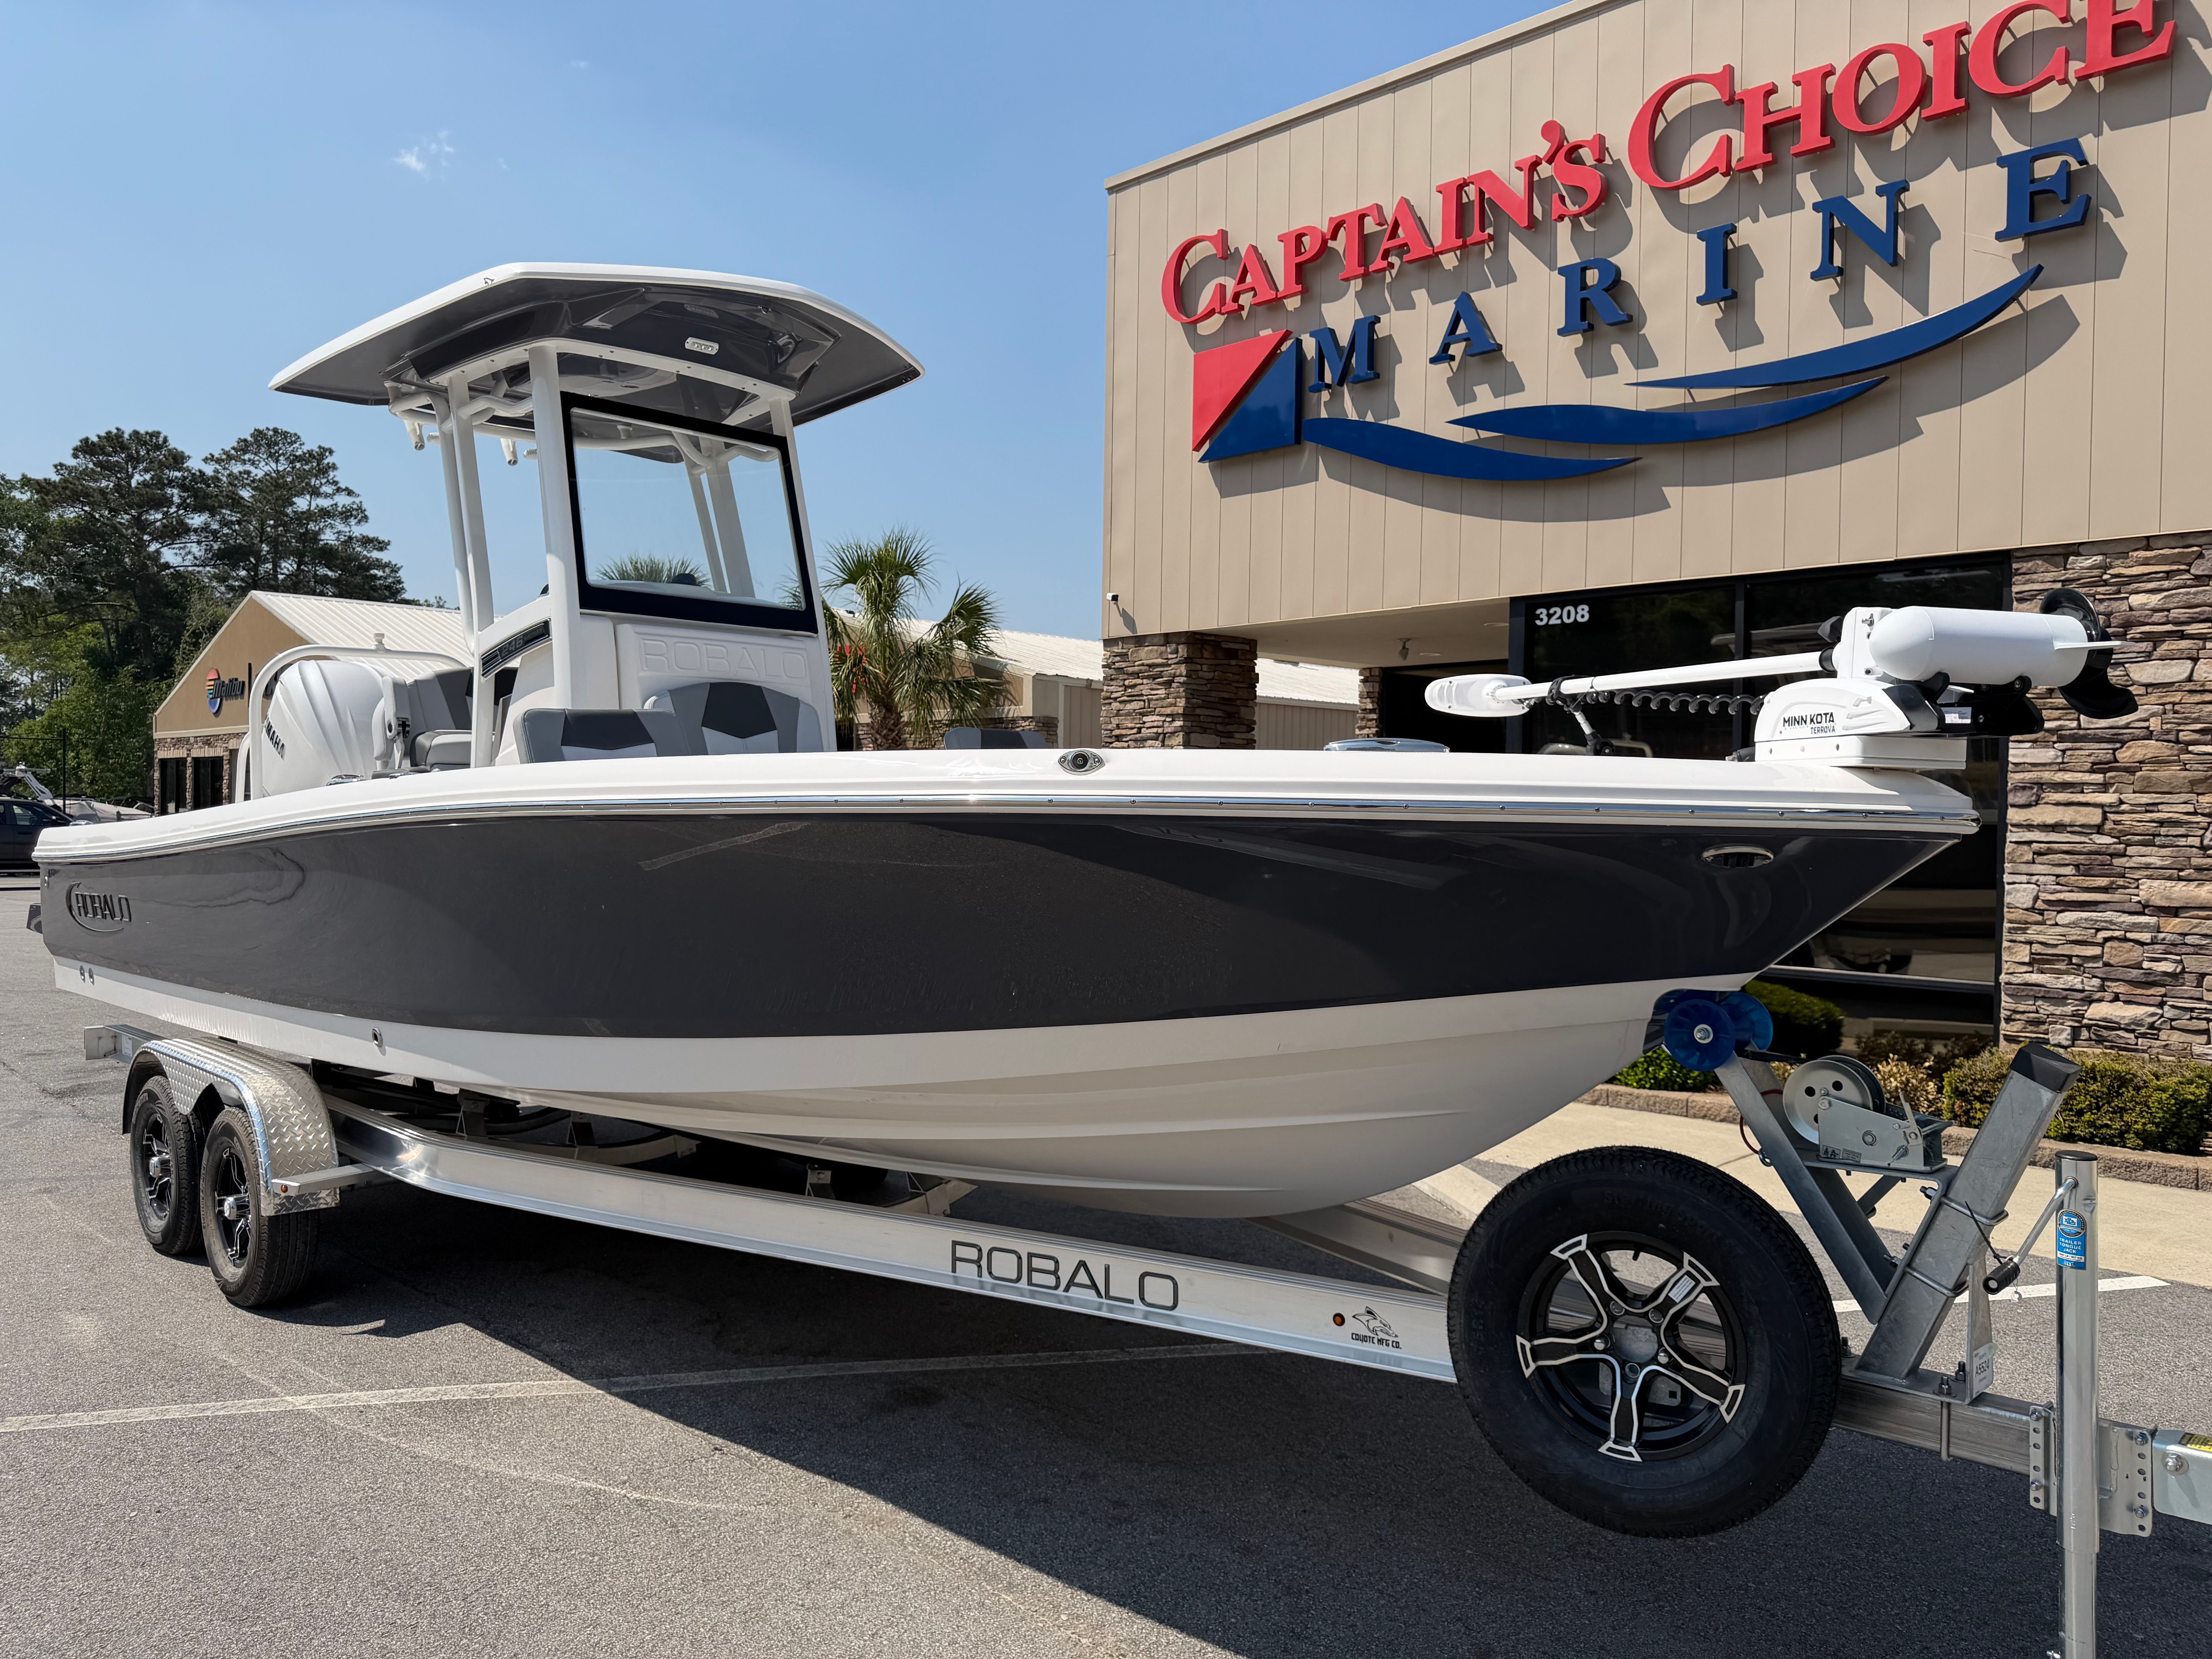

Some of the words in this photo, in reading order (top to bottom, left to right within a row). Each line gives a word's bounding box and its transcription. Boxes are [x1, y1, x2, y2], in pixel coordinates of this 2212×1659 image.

[1161, 120, 1606, 324] CAPTAIN'S
[1627, 0, 2178, 190] CHOICE
[1308, 137, 2091, 393] MARINE
[1535, 605, 1590, 626] 3208
[501, 636, 523, 658] 246
[641, 638, 807, 679] ROBALO
[1783, 714, 1807, 727] MINN
[1810, 712, 1834, 725] KOTA
[1810, 725, 1836, 735] TERROVA
[264, 716, 285, 759] MAHA
[75, 891, 132, 922] ROBALO
[2059, 1237, 2081, 1245] TRAILER
[951, 1240, 1178, 1311] ROBALO
[1351, 1333, 1375, 1344] COYOTE
[1377, 1337, 1389, 1347] MFG
[1392, 1341, 1402, 1349] CO.
